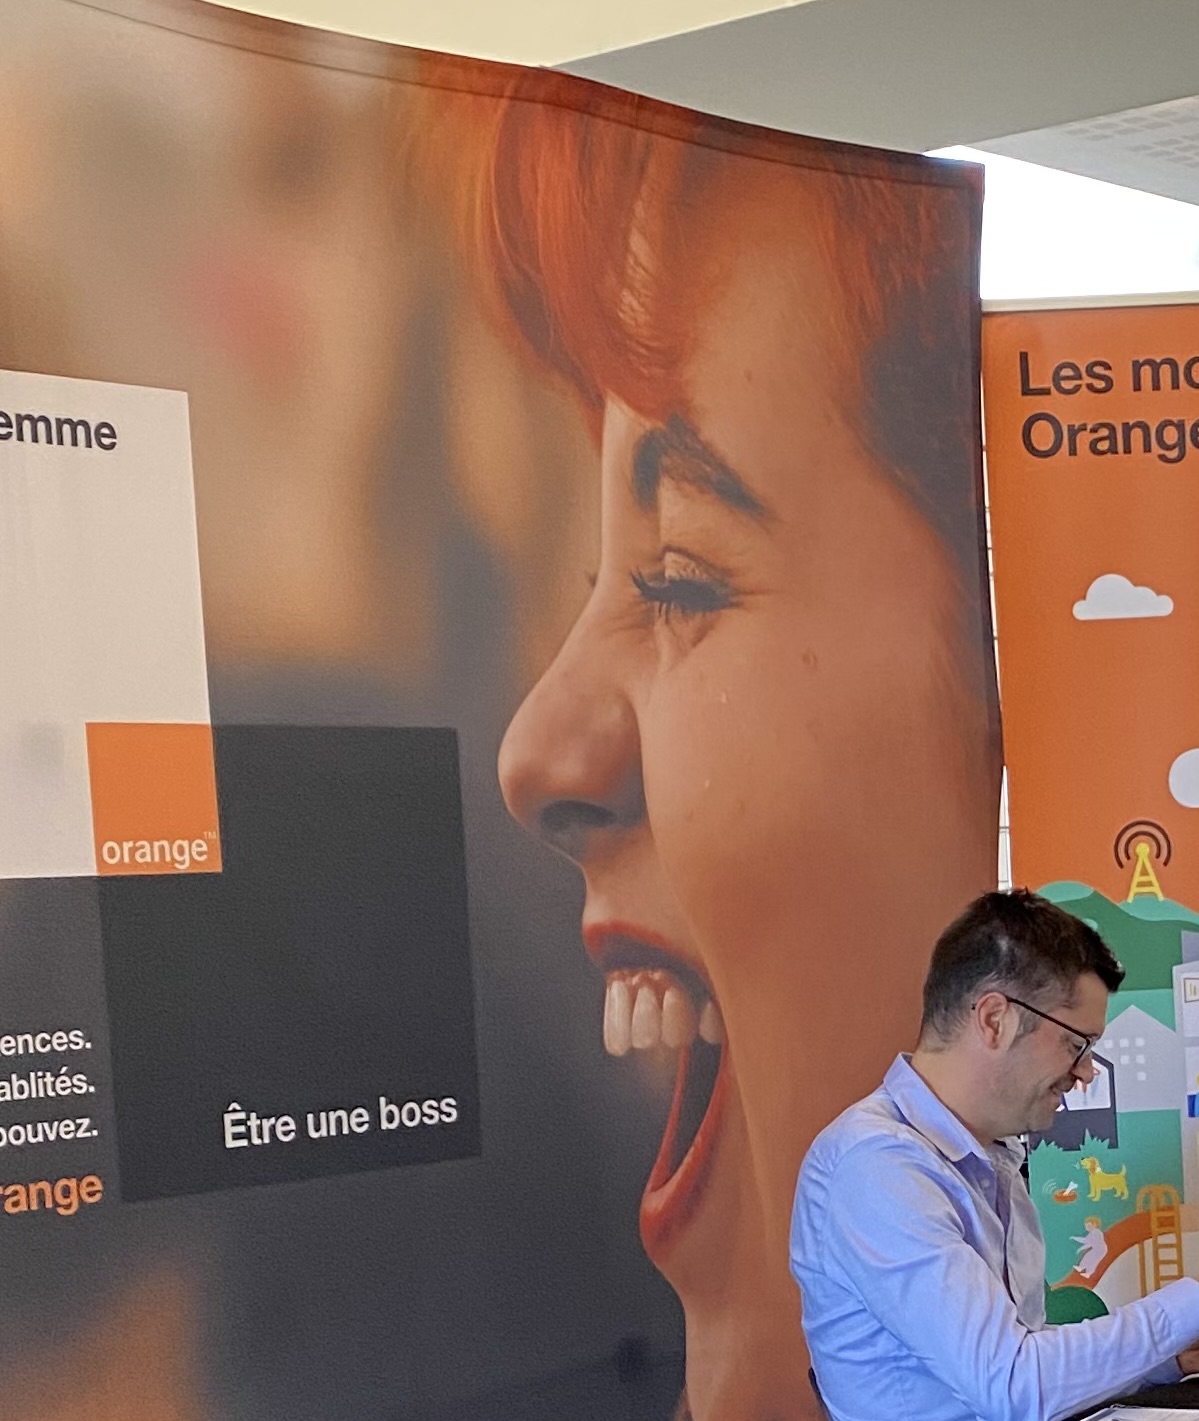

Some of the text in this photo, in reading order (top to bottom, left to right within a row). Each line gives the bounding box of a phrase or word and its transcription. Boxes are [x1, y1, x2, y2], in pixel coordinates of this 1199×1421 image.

[1019, 351, 1114, 396] Les
[102, 838, 208, 870] orange
[223, 1096, 458, 1149] Être une boss
